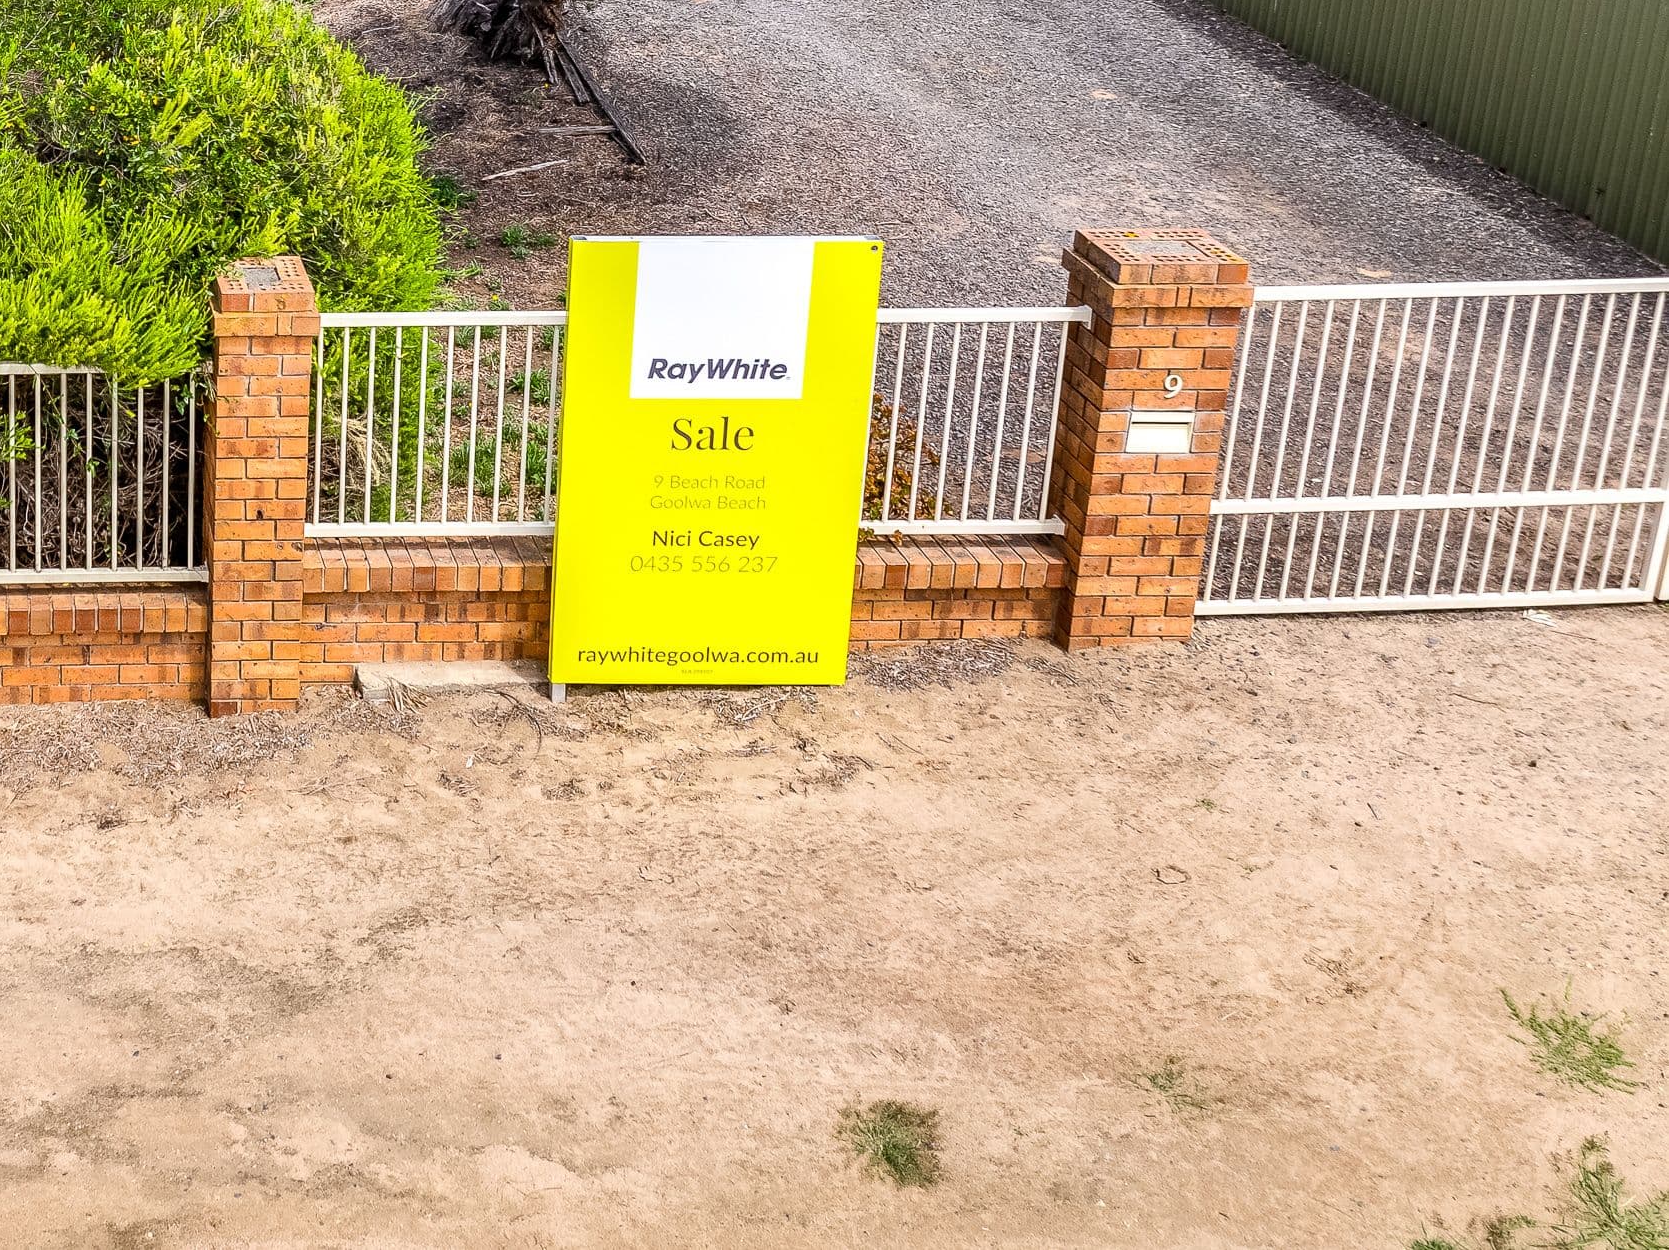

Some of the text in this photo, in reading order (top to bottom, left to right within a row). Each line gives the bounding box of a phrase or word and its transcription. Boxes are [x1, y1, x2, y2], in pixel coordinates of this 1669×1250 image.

[1164, 374, 1183, 399] 9
[671, 416, 755, 451] Sale
[654, 475, 766, 489] 9 Beach Road
[650, 495, 766, 510] Goolwa Beach
[652, 530, 760, 551] Nici Casey
[630, 555, 779, 573] 0435 556 237
[578, 646, 819, 666] raywhitegoolwa.com.au
